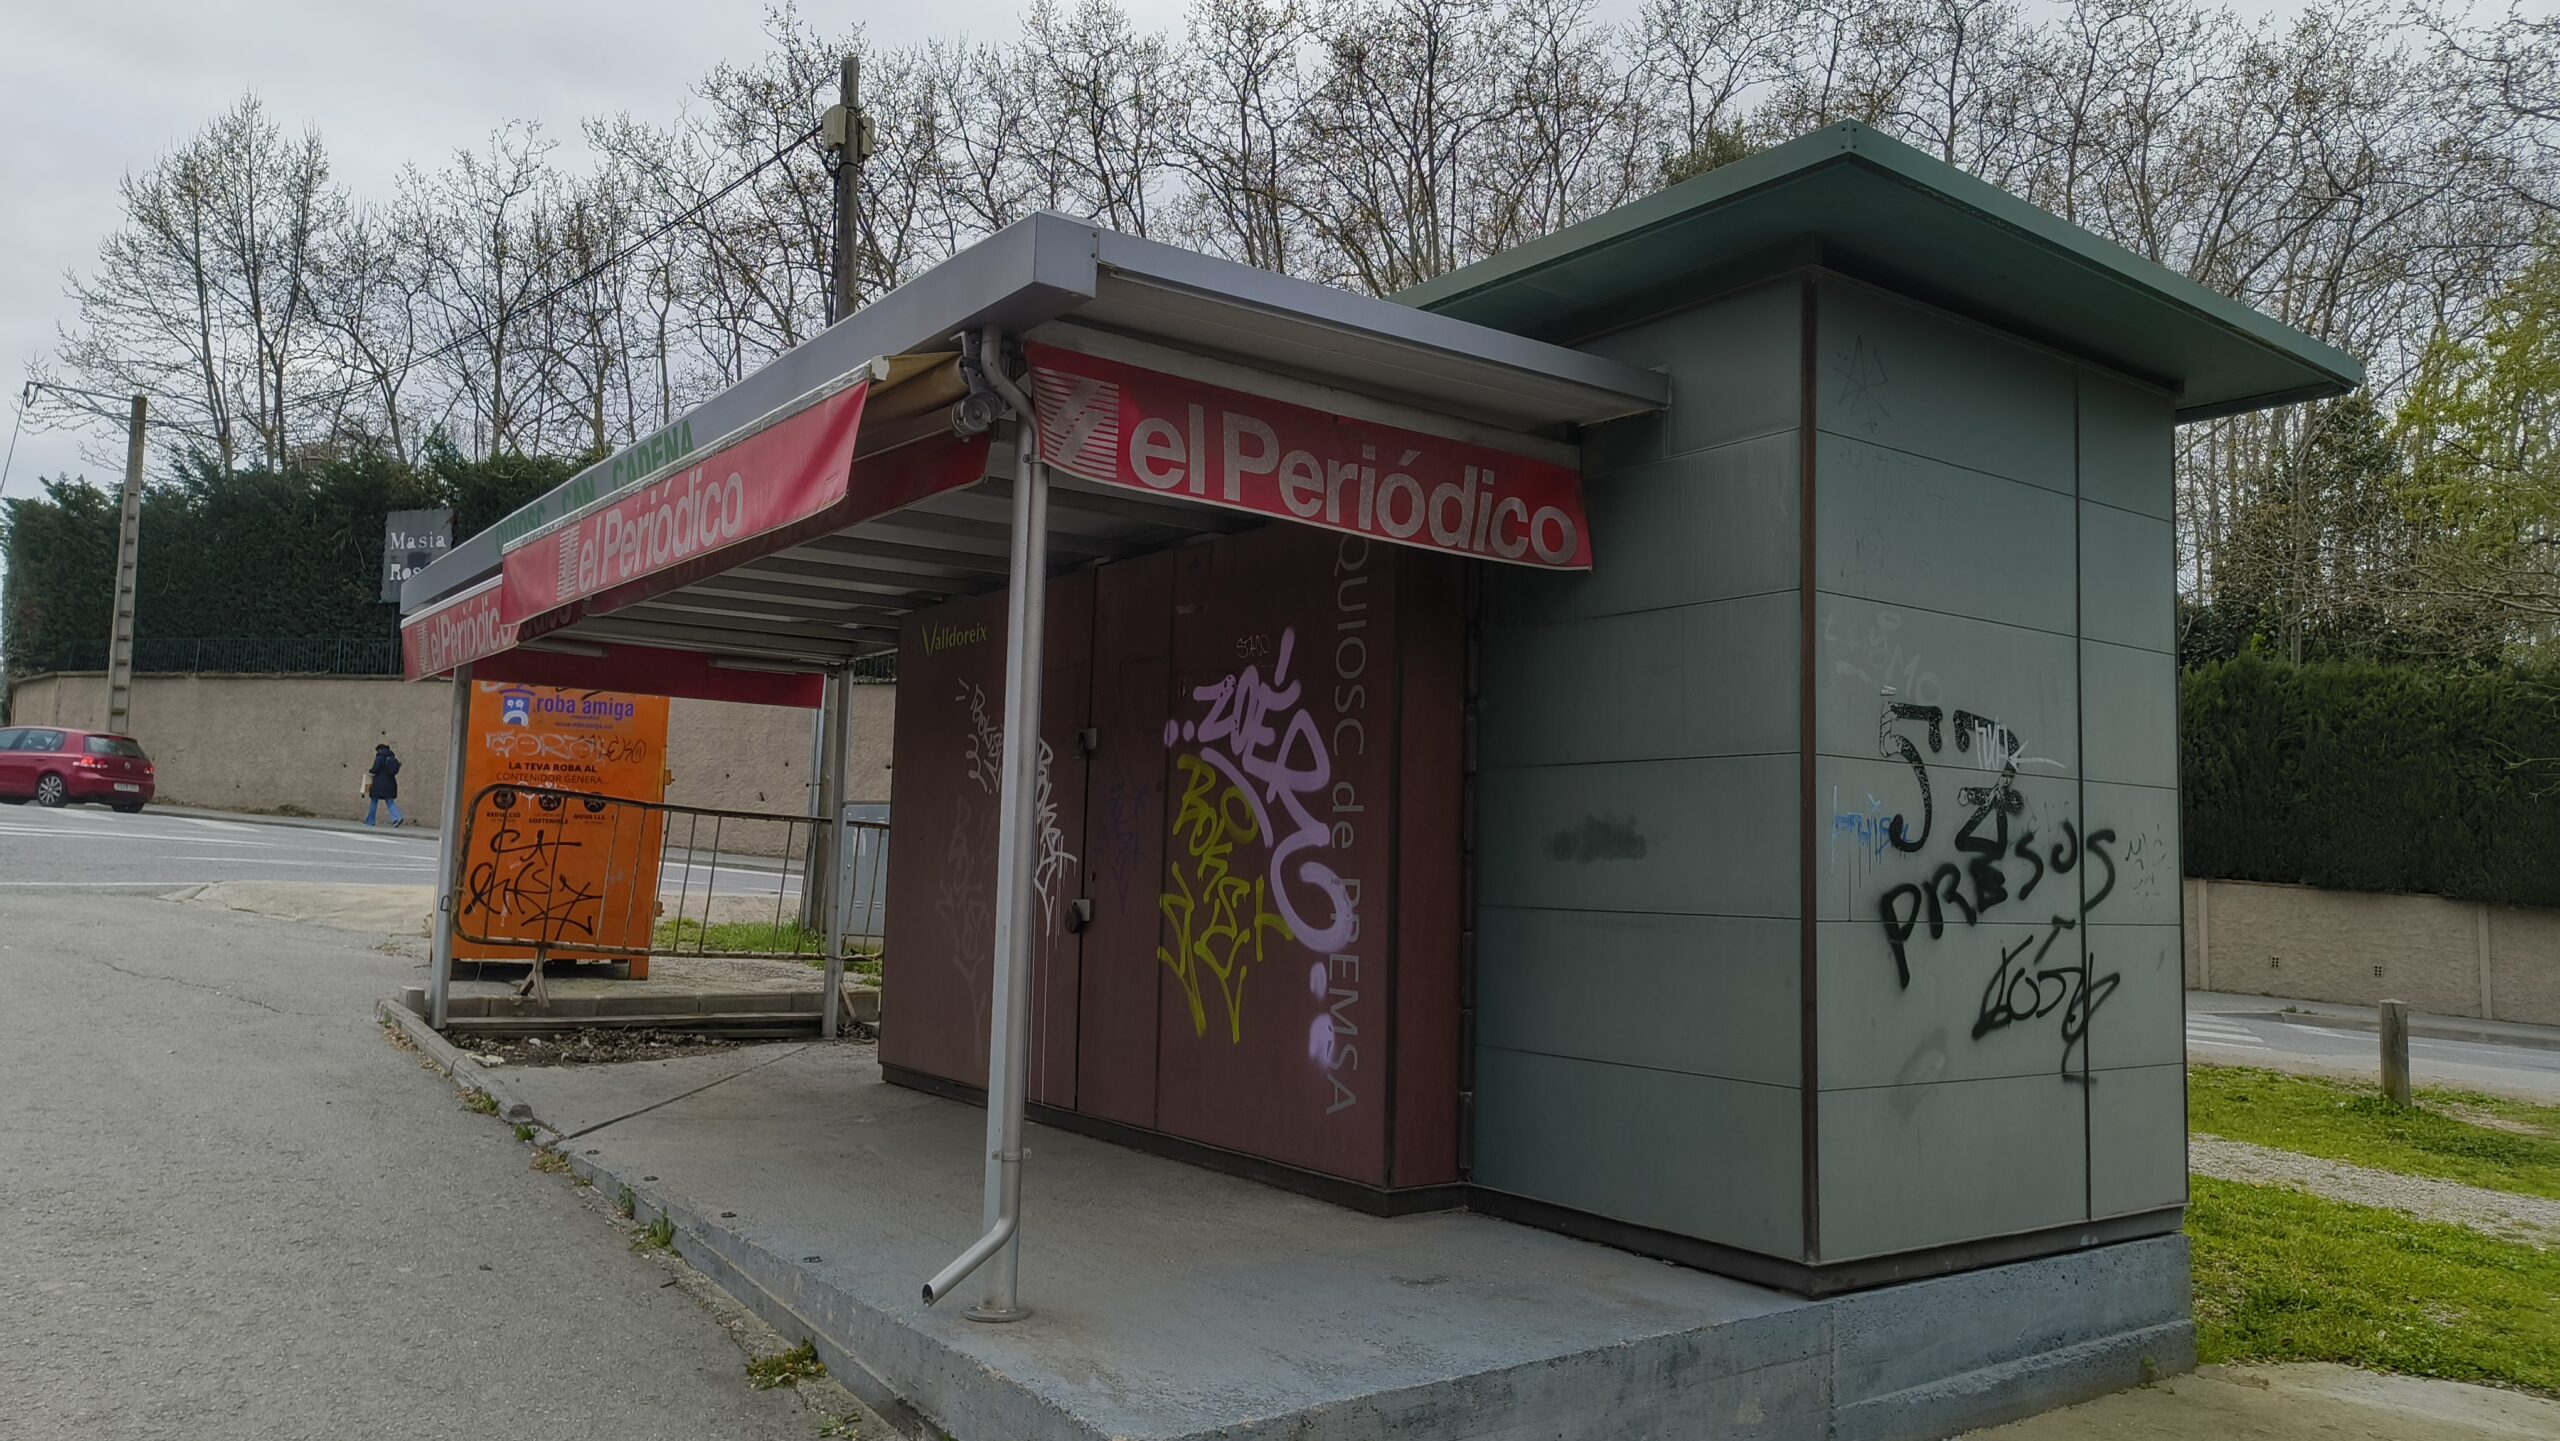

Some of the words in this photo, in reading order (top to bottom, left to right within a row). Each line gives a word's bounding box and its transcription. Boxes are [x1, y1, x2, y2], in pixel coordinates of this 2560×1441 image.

[561, 475, 596, 515] CAN
[612, 420, 694, 490] CADENA
[1129, 403, 1206, 495] el
[1222, 410, 1578, 565] Periódico
[390, 531, 446, 550] Masia
[578, 517, 602, 593] el
[600, 467, 743, 584] Periódico
[920, 620, 987, 657] Valldoreix
[536, 694, 576, 714] roba
[582, 697, 634, 720] amiga
[496, 772, 562, 783] CONTENIDOR
[509, 762, 521, 770] LA
[525, 763, 550, 771] TEVA
[554, 763, 581, 772] ROBA
[584, 765, 597, 773] AL
[1331, 780, 1364, 850] de
